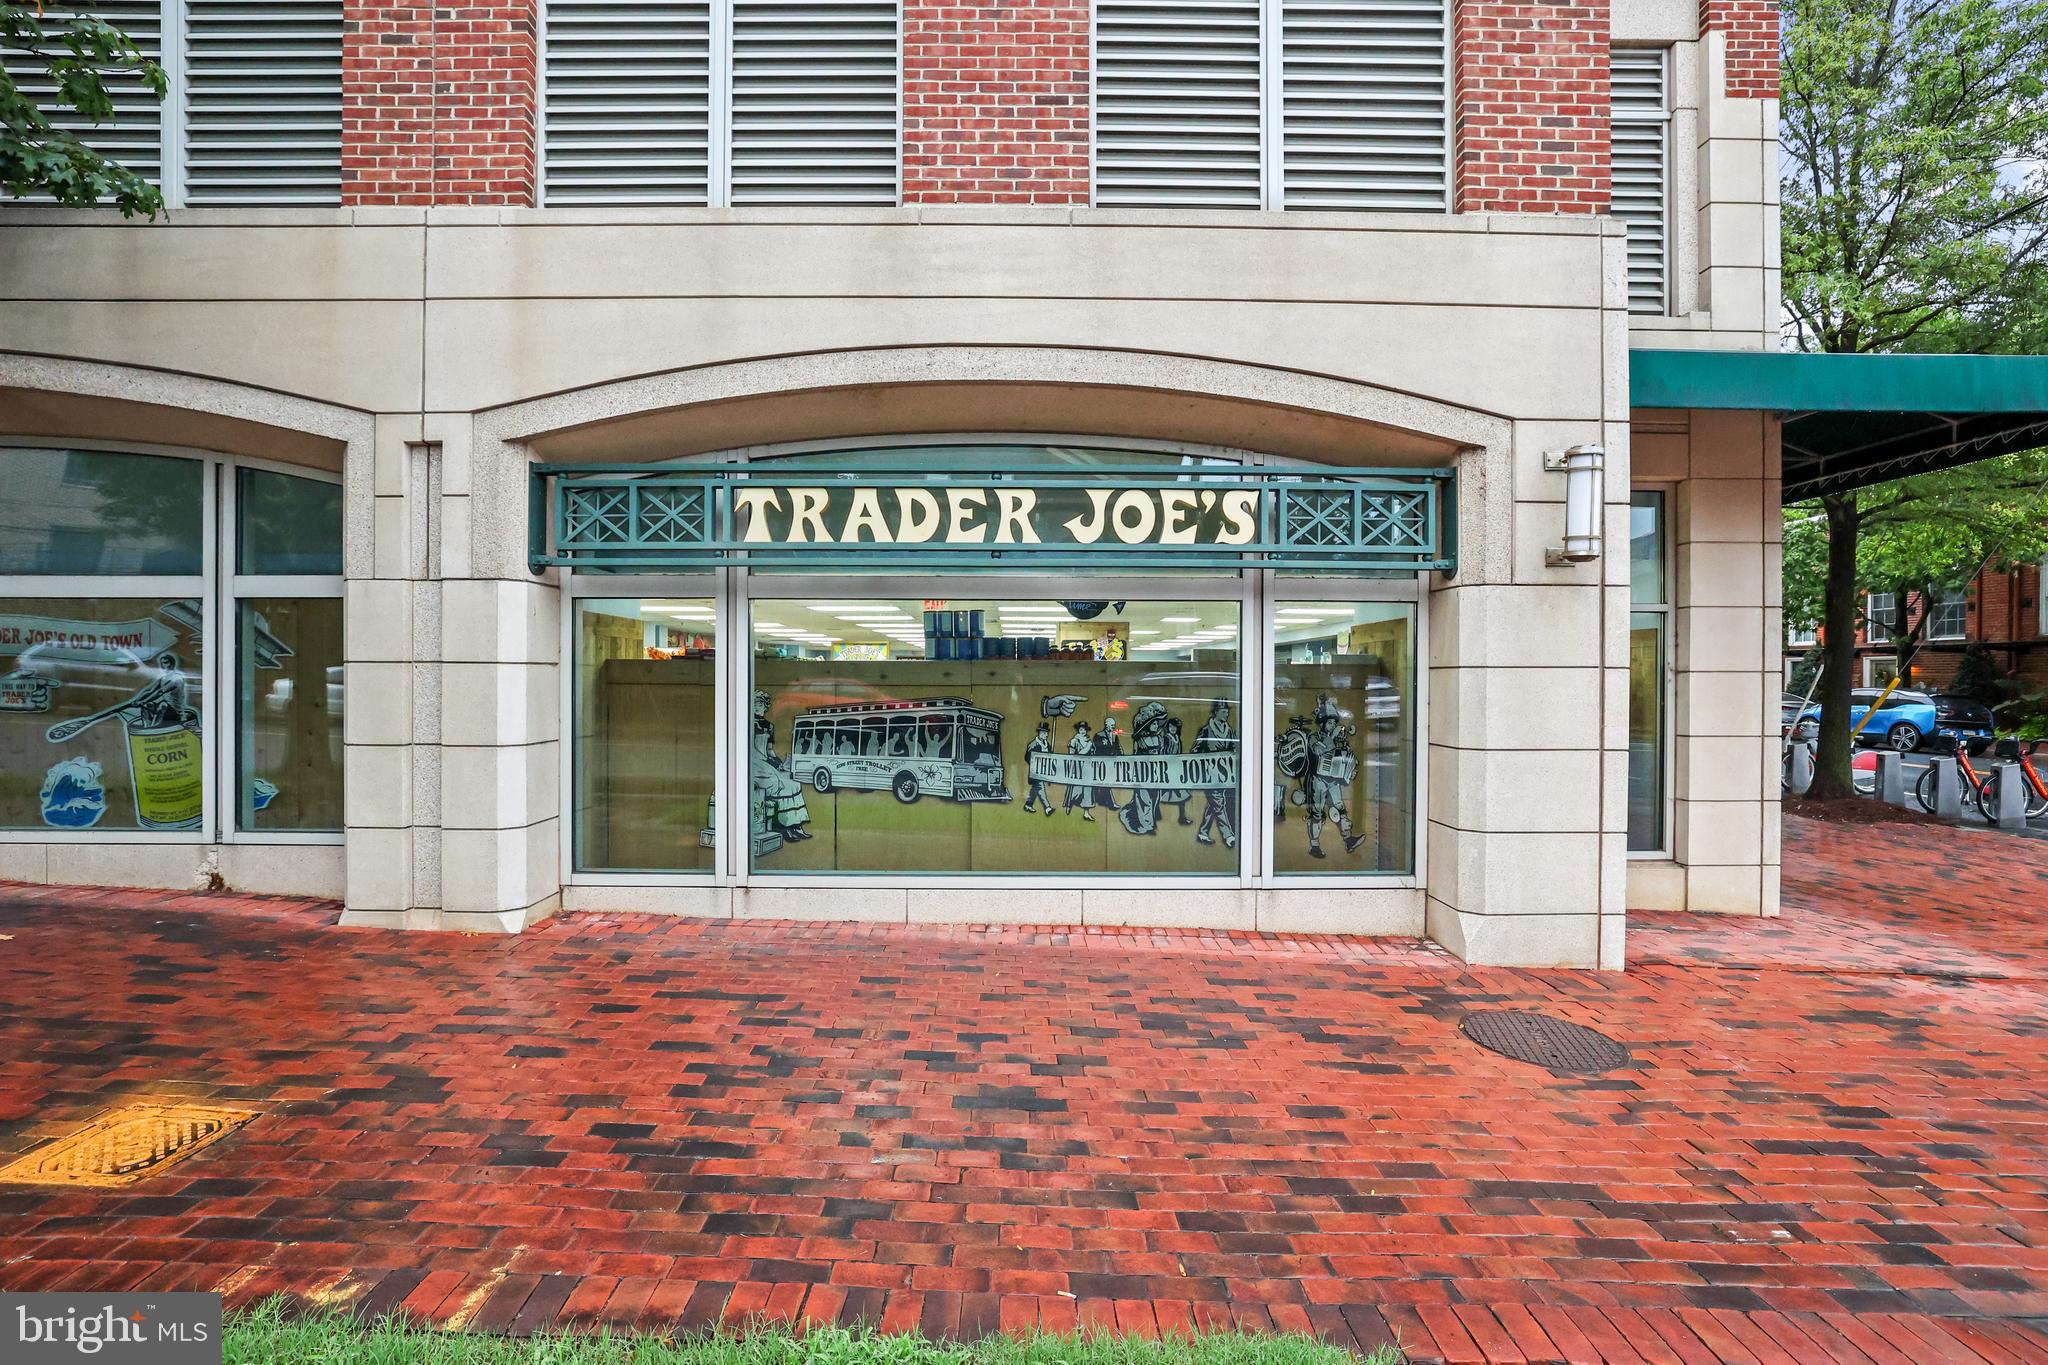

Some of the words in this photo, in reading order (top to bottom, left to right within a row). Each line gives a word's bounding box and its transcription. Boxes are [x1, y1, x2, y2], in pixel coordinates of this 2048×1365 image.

[734, 487, 1042, 544] TRADER
[1062, 488, 1260, 545] JOE'S
[25, 629, 67, 649] JOE'S
[70, 633, 97, 650] OLD
[102, 632, 143, 650] TOWN
[966, 714, 985, 727] TRADER
[147, 749, 188, 765] CORN
[865, 760, 892, 773] TROLLEY
[1034, 756, 1058, 777] THIS
[1063, 759, 1085, 780] WAY
[1091, 760, 1106, 781] TO
[1113, 760, 1170, 784] TRADER
[1179, 755, 1236, 784] JOE'S!
